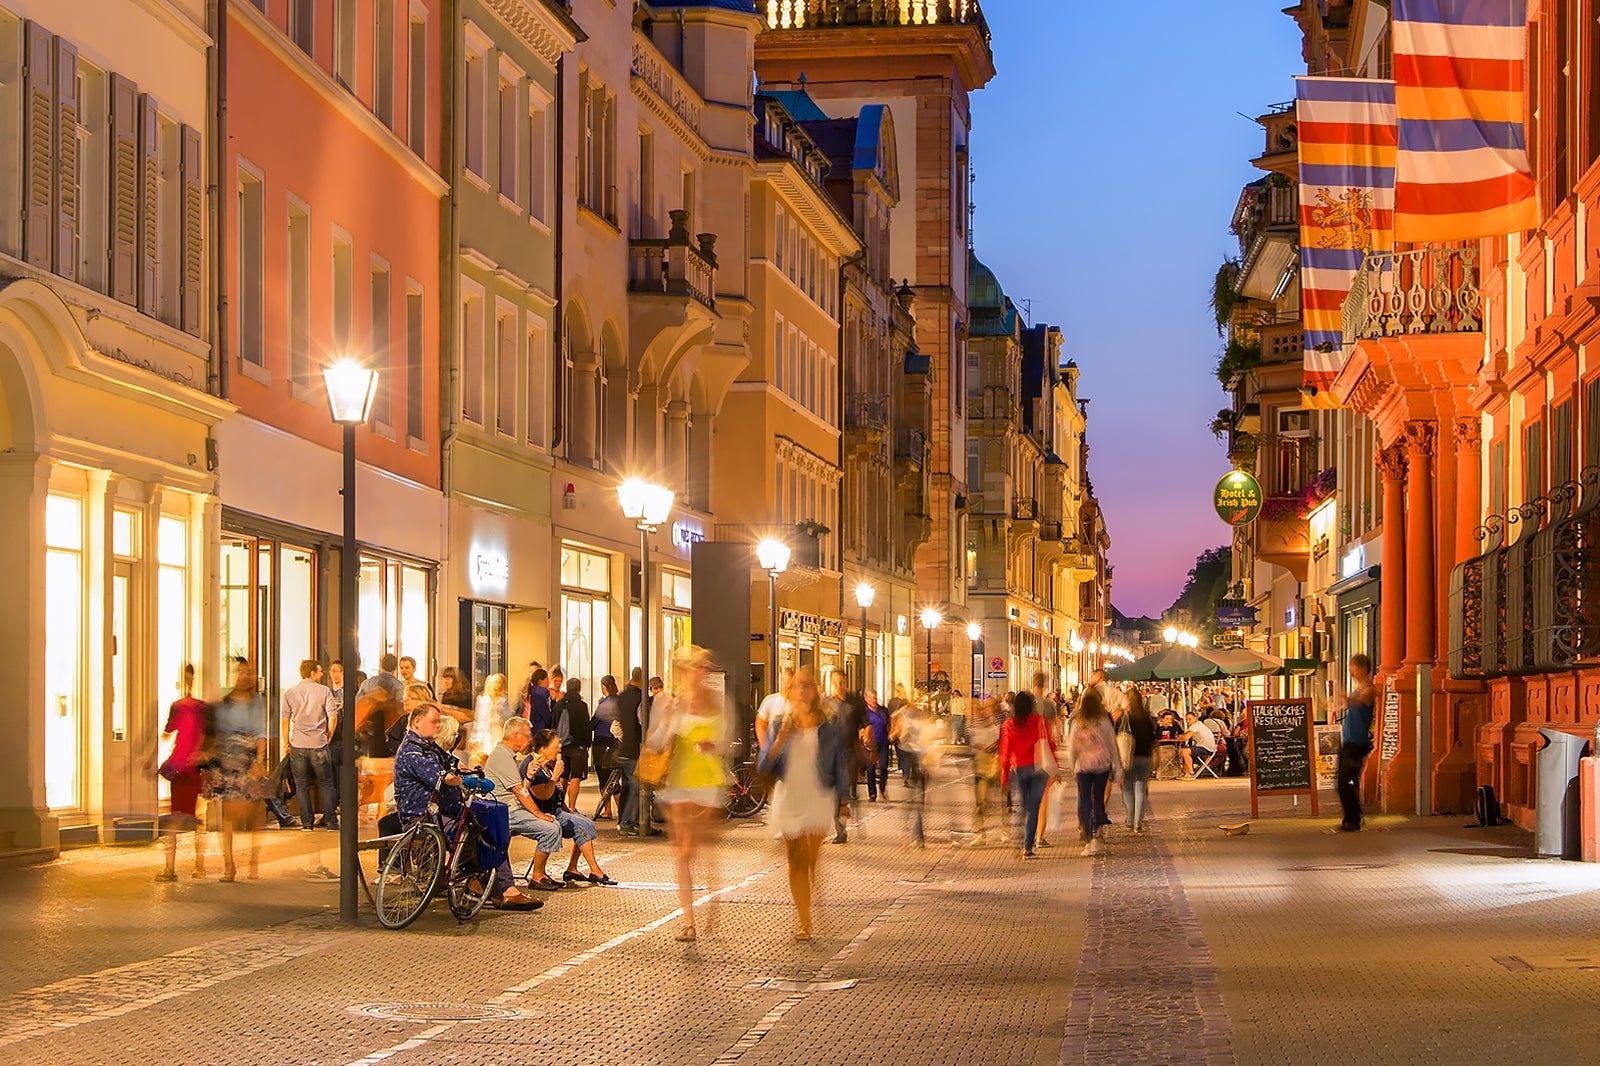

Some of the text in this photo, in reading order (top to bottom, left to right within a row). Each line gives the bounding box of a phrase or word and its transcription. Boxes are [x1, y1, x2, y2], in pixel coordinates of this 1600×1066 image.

[1220, 489, 1256, 499] Hotel &
[1217, 498, 1258, 508] Irish Pub
[1254, 716, 1304, 727] RESTAURANT
